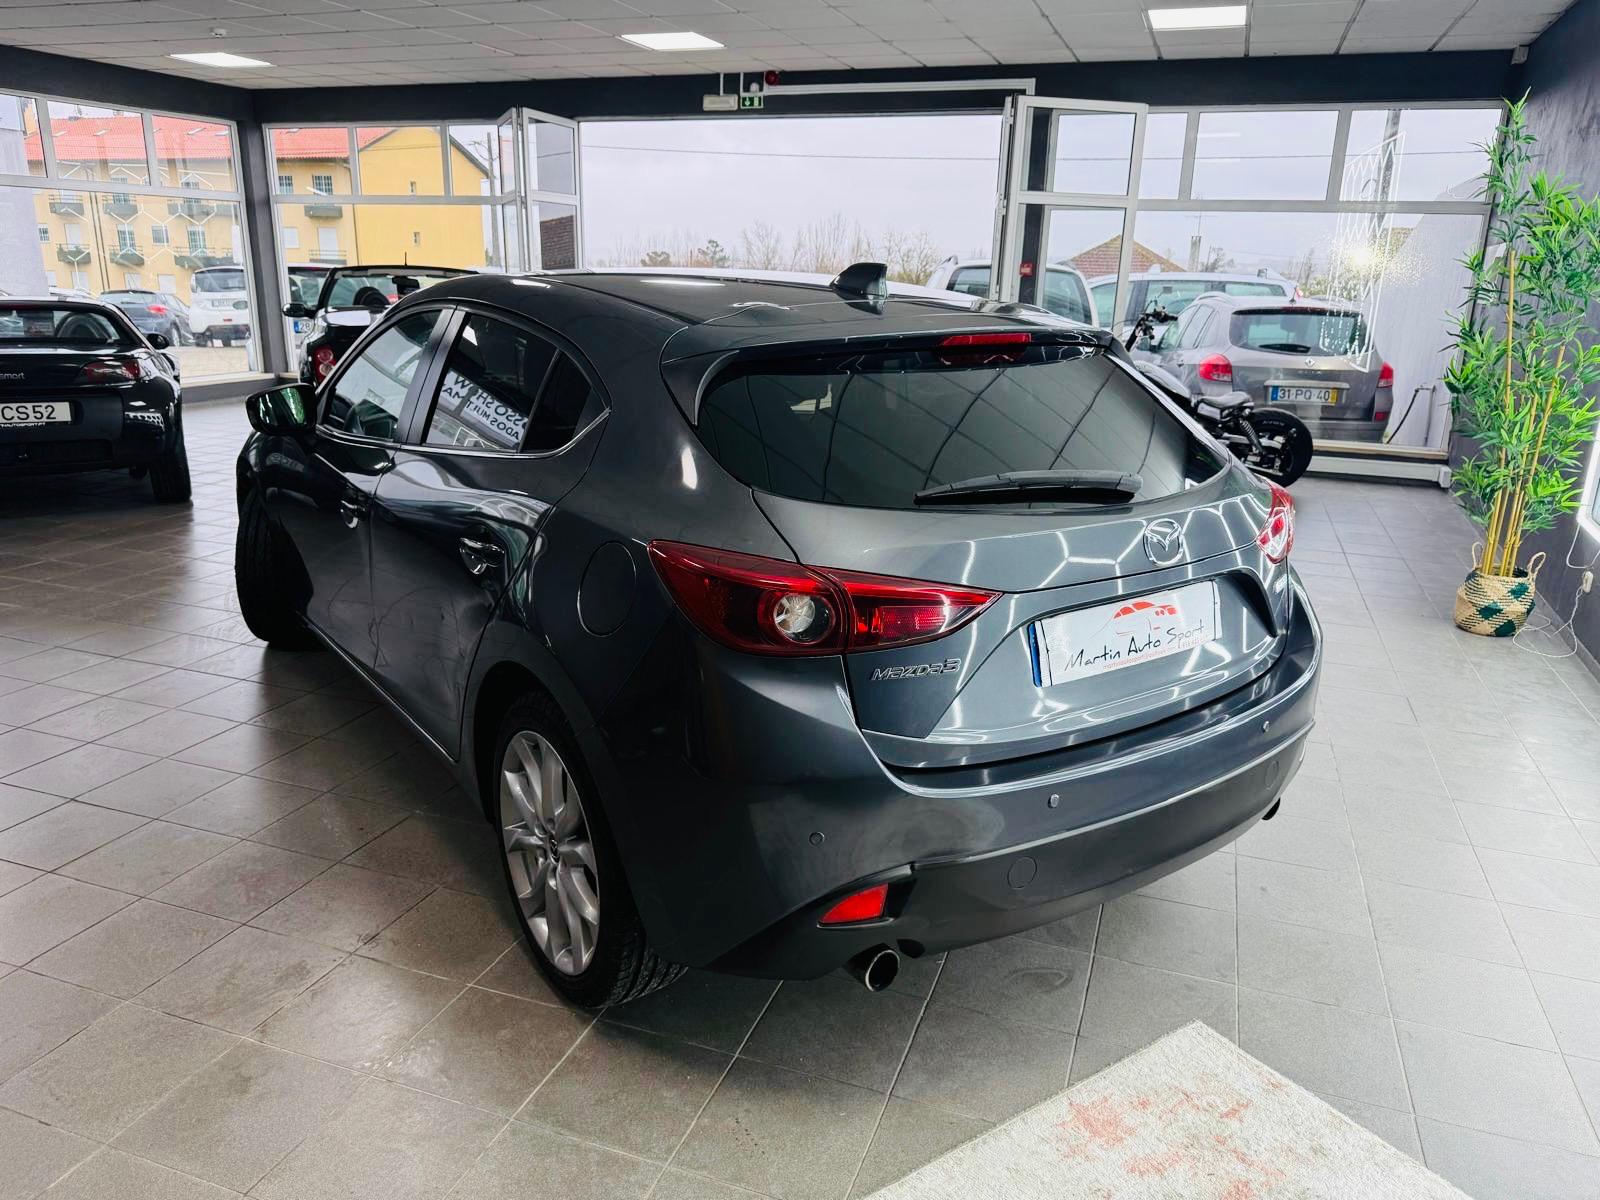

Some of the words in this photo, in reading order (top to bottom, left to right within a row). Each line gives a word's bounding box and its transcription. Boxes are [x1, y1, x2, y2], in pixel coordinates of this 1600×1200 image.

[1064, 645, 1121, 671] Martin
[1127, 633, 1161, 657] Auto
[1166, 618, 1205, 650] Sport
